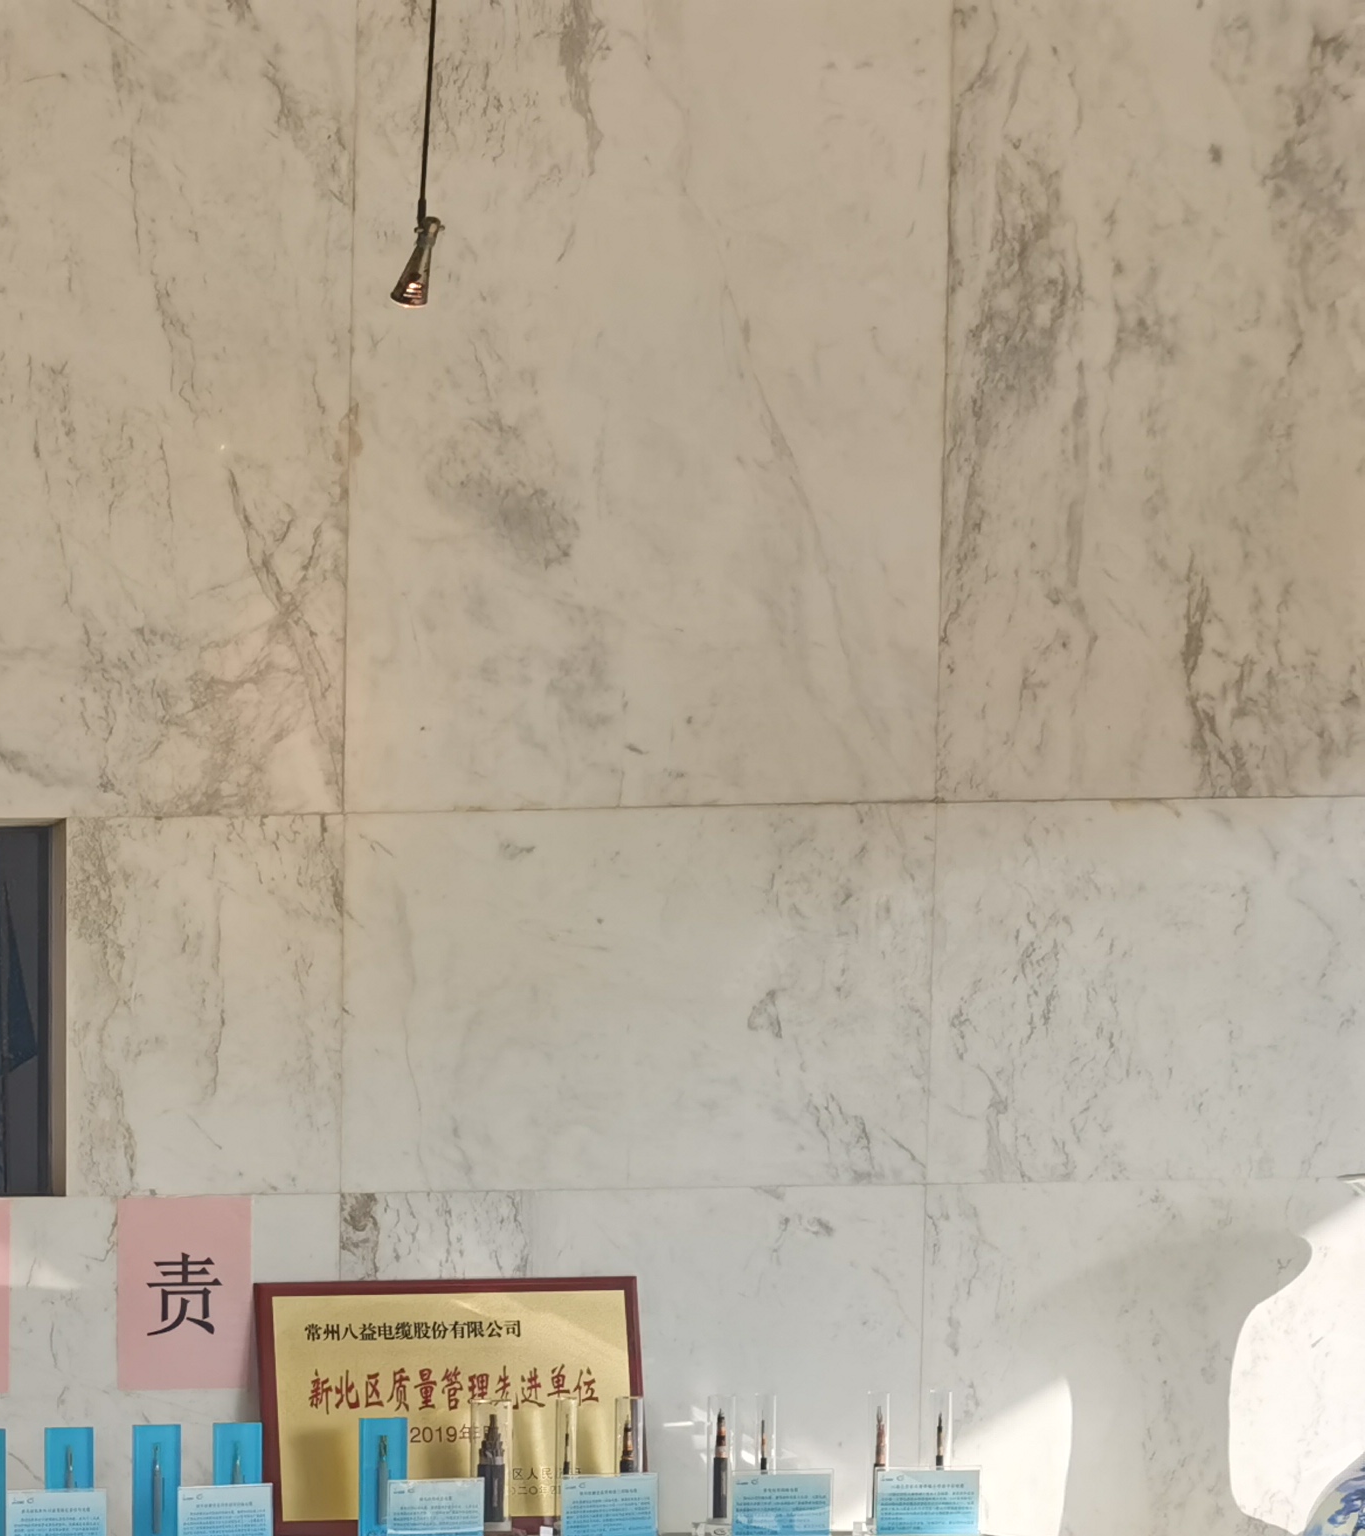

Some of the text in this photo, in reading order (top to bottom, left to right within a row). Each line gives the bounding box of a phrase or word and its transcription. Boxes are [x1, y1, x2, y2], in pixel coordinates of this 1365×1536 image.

[145, 1252, 223, 1337] 责
[304, 1319, 522, 1342] 常州八益电缆股份有限公司
[308, 1363, 600, 1416] 新北区质量管理先进单位
